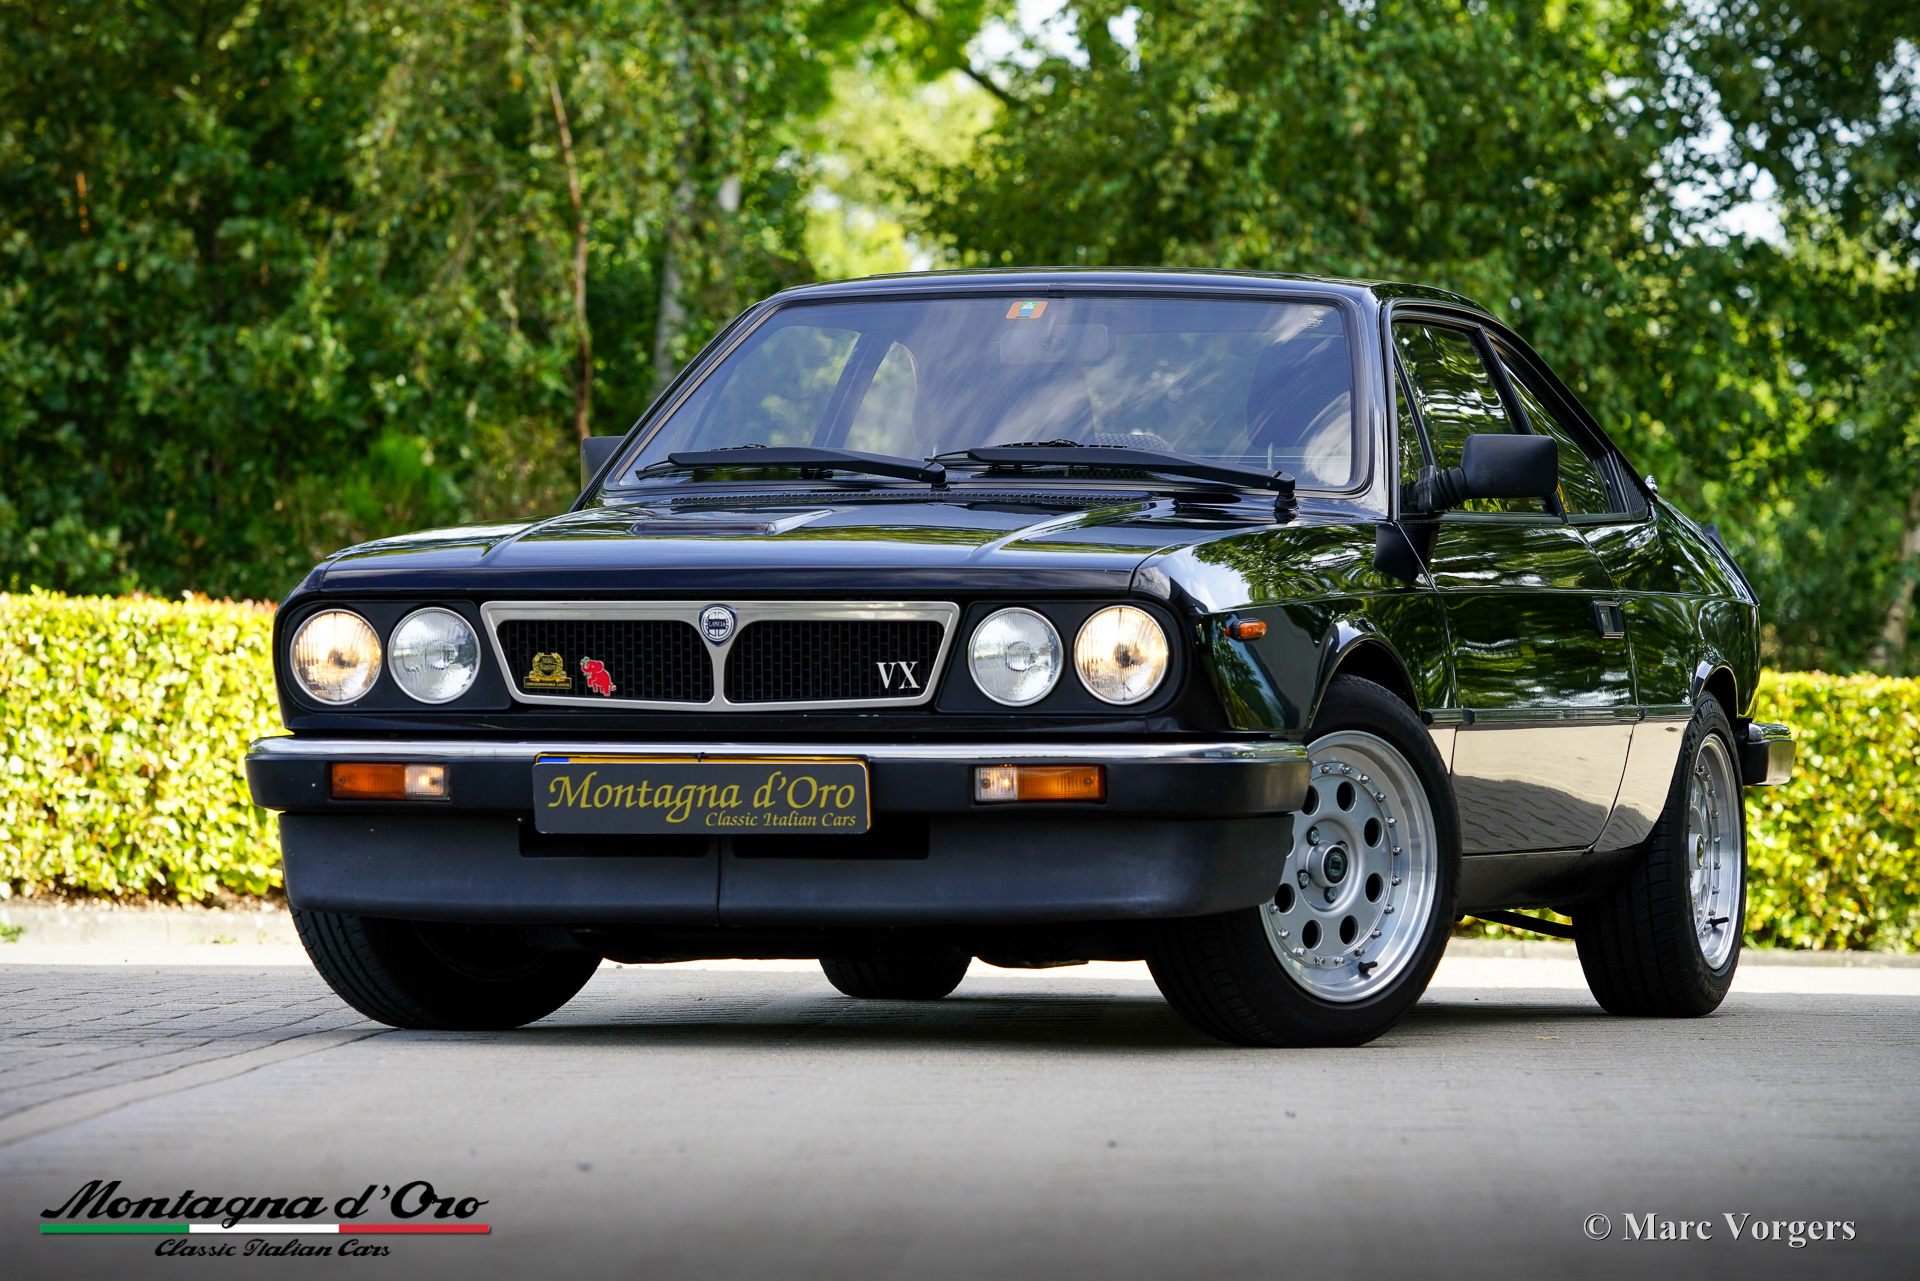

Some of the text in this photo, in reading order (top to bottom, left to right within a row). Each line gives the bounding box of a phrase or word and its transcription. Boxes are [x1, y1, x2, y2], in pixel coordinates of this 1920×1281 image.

[876, 661, 921, 690] VX
[548, 771, 856, 824] Montagna d'Oro
[705, 811, 856, 827] Classic Italian Cars
